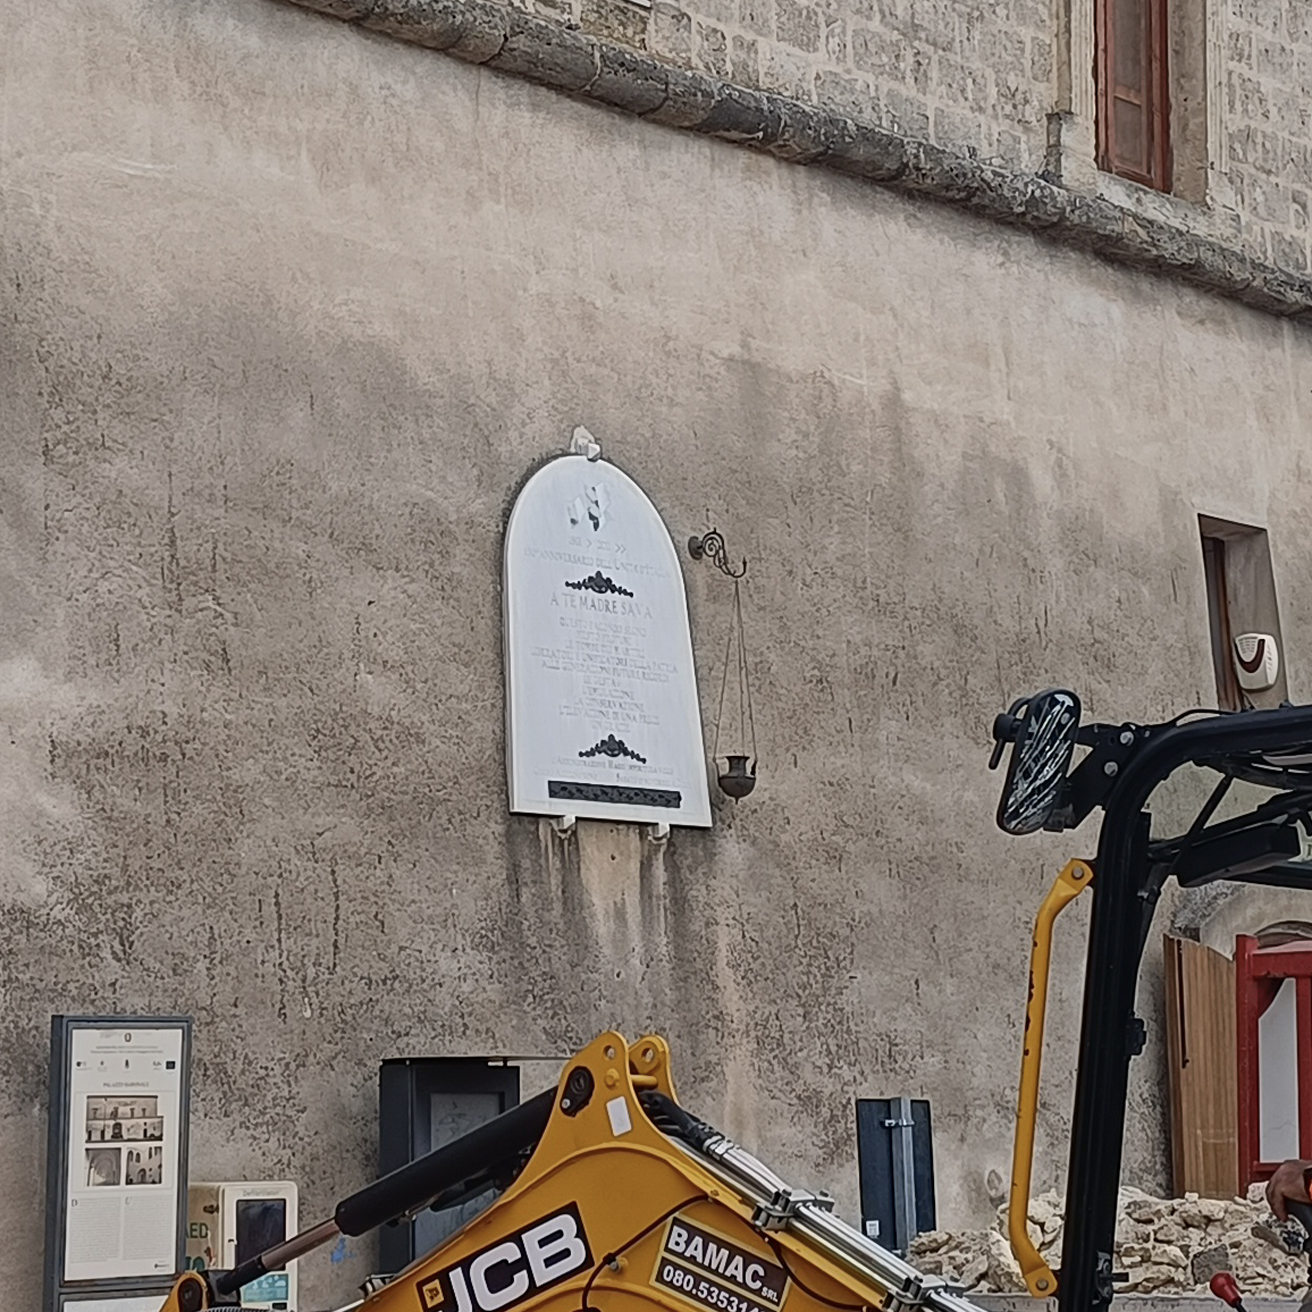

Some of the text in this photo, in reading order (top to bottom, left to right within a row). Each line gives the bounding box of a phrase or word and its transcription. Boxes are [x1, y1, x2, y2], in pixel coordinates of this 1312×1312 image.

[550, 592, 559, 607] A
[561, 593, 577, 609] TE
[579, 596, 617, 615] MADRE
[185, 1222, 208, 1238] ED
[668, 1225, 779, 1303] BAMAC SRL
